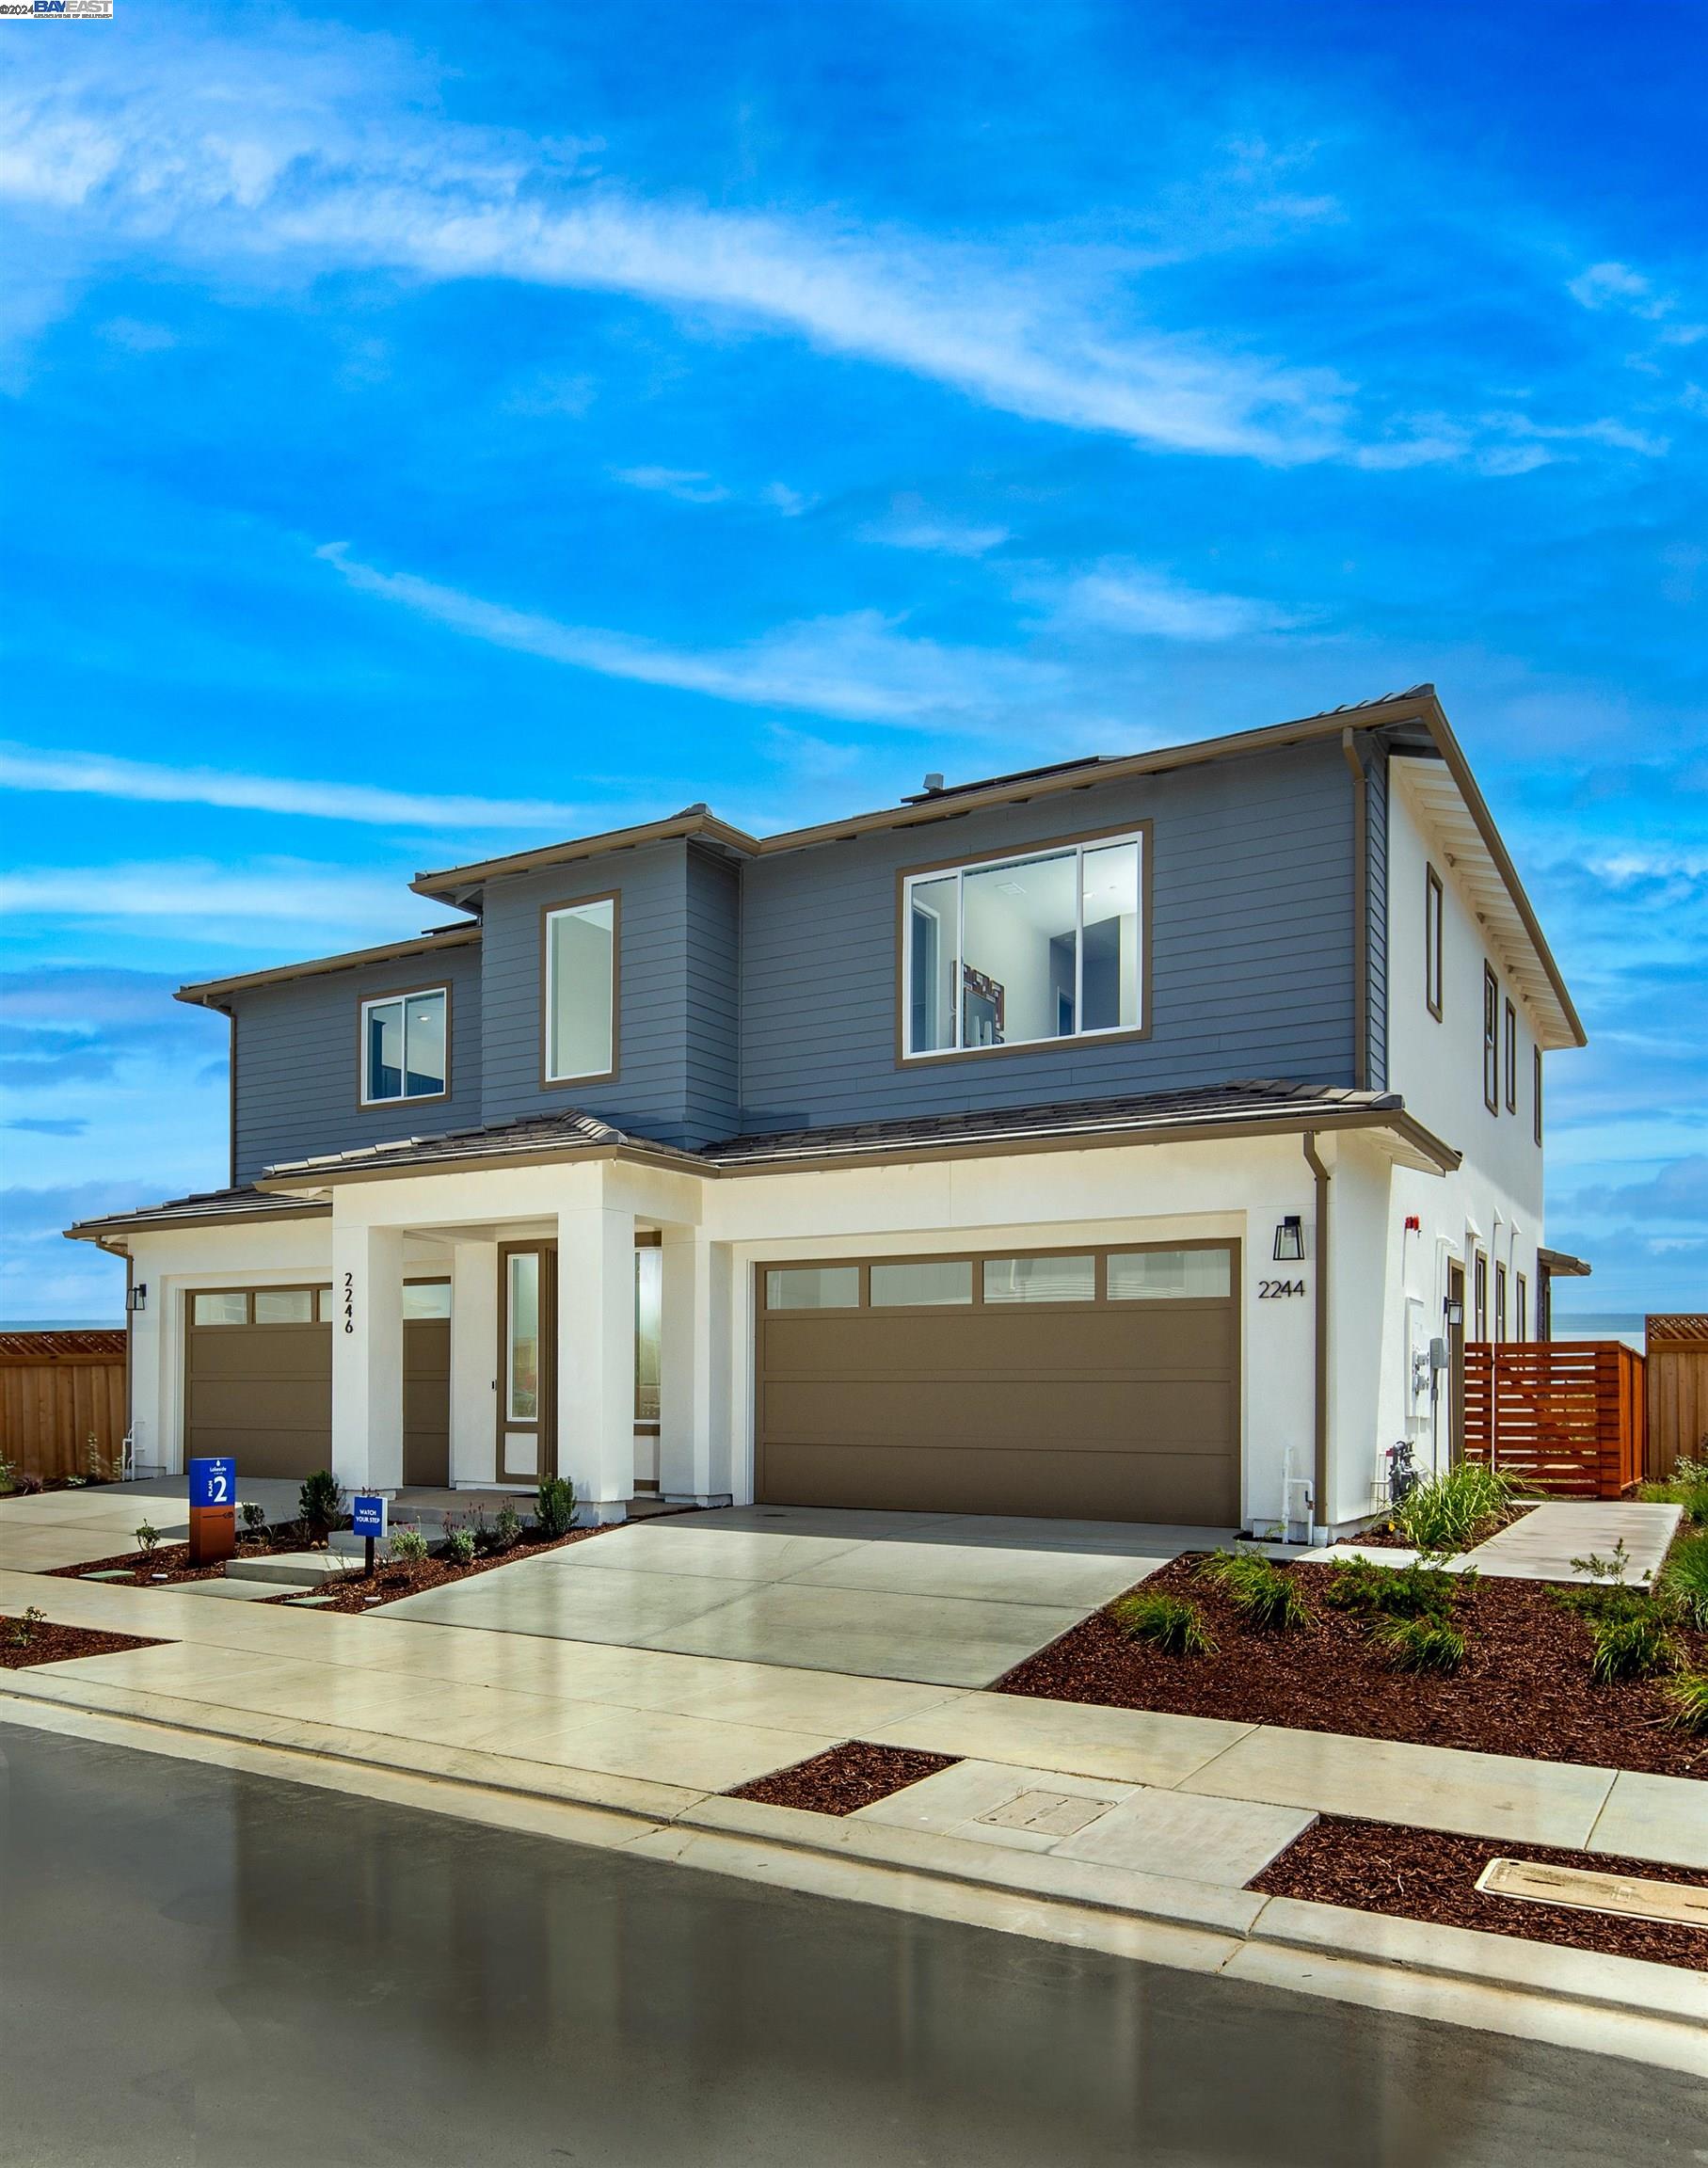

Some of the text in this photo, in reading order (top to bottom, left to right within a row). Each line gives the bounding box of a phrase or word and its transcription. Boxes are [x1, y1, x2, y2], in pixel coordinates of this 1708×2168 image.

[344, 1272, 353, 1333] 2246
[1258, 1280, 1305, 1299] 2244
[214, 1475, 228, 1503] 2
